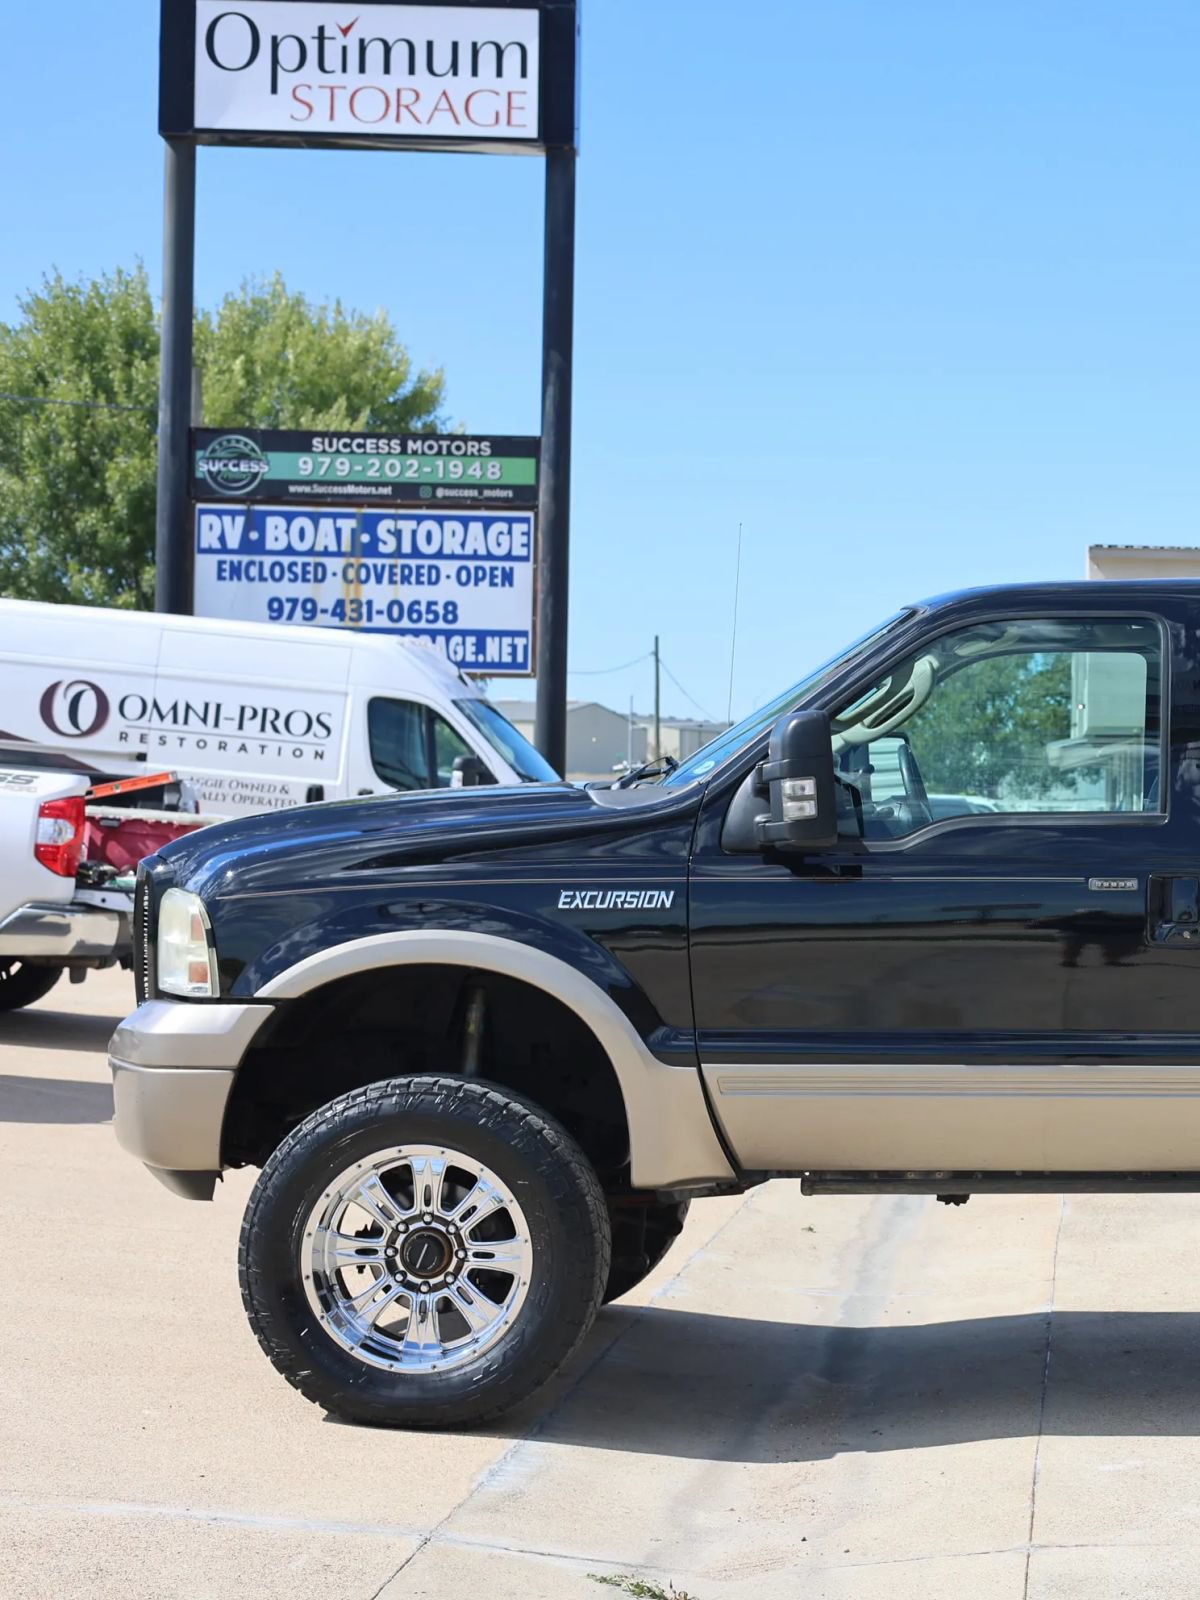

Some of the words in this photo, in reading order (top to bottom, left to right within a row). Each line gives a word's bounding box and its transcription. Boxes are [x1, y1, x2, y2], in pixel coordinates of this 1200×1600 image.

[205, 11, 528, 95] Optimum
[289, 84, 527, 128] STORAGE
[311, 437, 401, 454] SUCCESS
[407, 440, 492, 456] MOTORS
[198, 459, 270, 473] SUCCESS
[298, 456, 503, 480] 979-202-1948
[200, 514, 245, 549] RV
[265, 516, 357, 552] BOAT
[376, 518, 529, 556] STORAGE
[216, 560, 328, 583] ENCLOSED
[342, 562, 441, 587] COVERED
[455, 565, 515, 587] OPEN
[267, 596, 459, 624] 979-431-0658
[118, 694, 333, 740] OMNI-PROS
[118, 731, 325, 760] RESTORATION
[558, 890, 675, 909] EXCURSION
